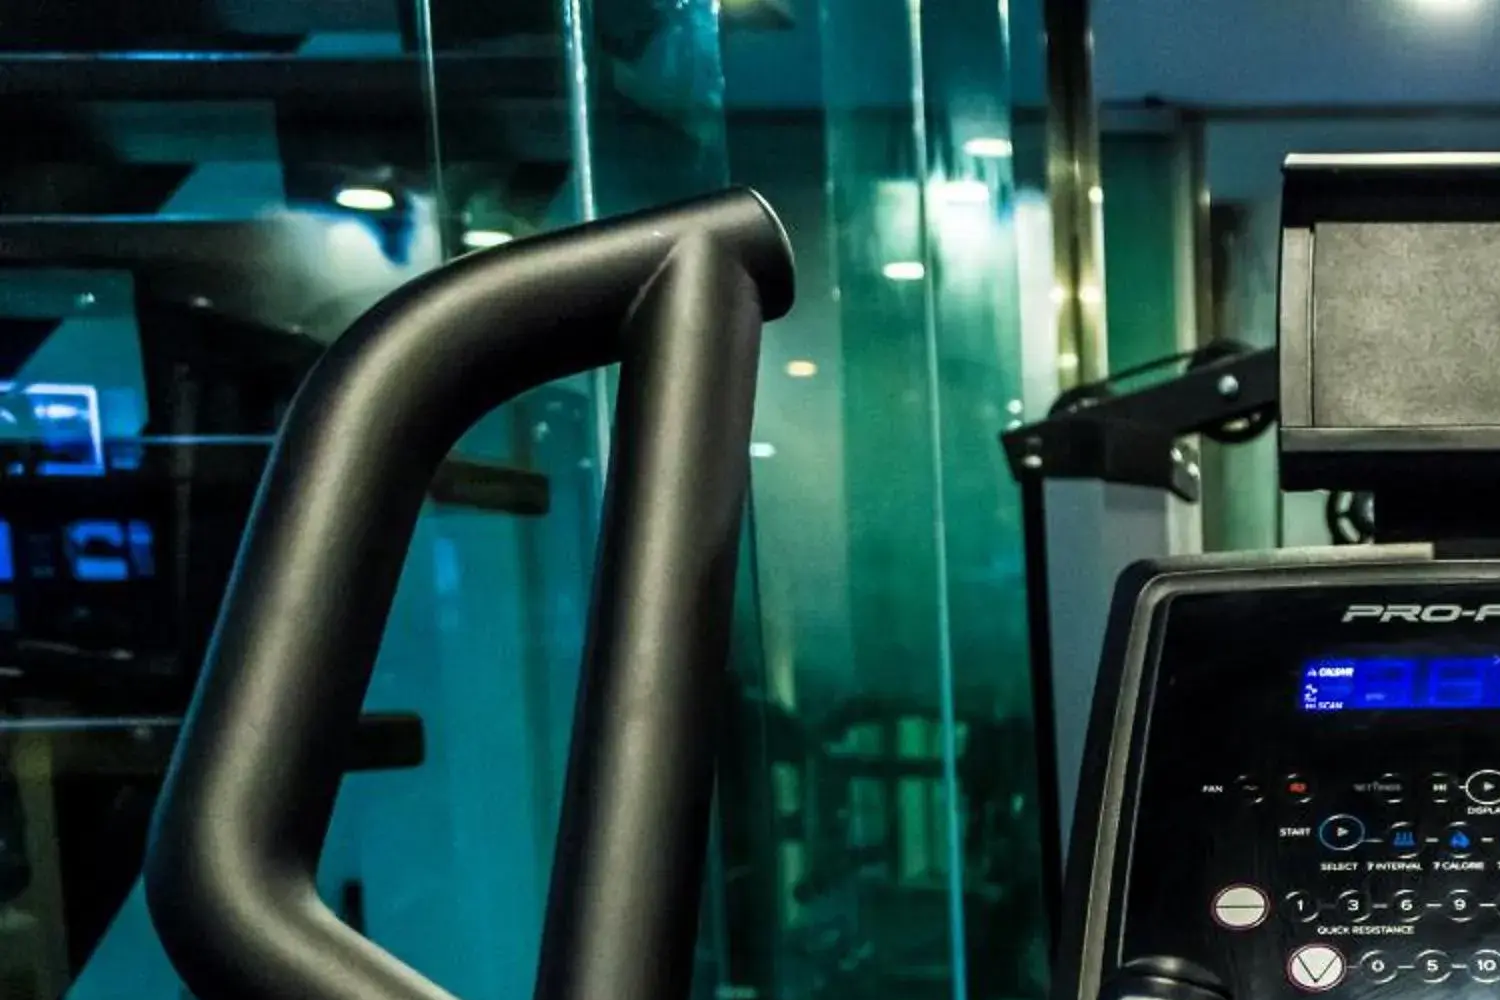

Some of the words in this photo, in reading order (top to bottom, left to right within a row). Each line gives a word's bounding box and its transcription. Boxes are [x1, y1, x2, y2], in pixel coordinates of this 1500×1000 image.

[1202, 784, 1223, 793] FAN
[1279, 827, 1311, 836] START
[1320, 862, 1358, 871] SELECT
[1375, 861, 1423, 871] INTERVAL
[1441, 861, 1485, 870] CALORIE
[1347, 899, 1359, 911] 3
[1401, 899, 1413, 911] 6
[1453, 898, 1466, 911] 9
[1317, 926, 1349, 935] QUICK
[1352, 925, 1415, 935] RESISTANCE
[1371, 960, 1385, 972] 0
[1426, 960, 1439, 971] 5
[1477, 960, 1497, 971] 10
